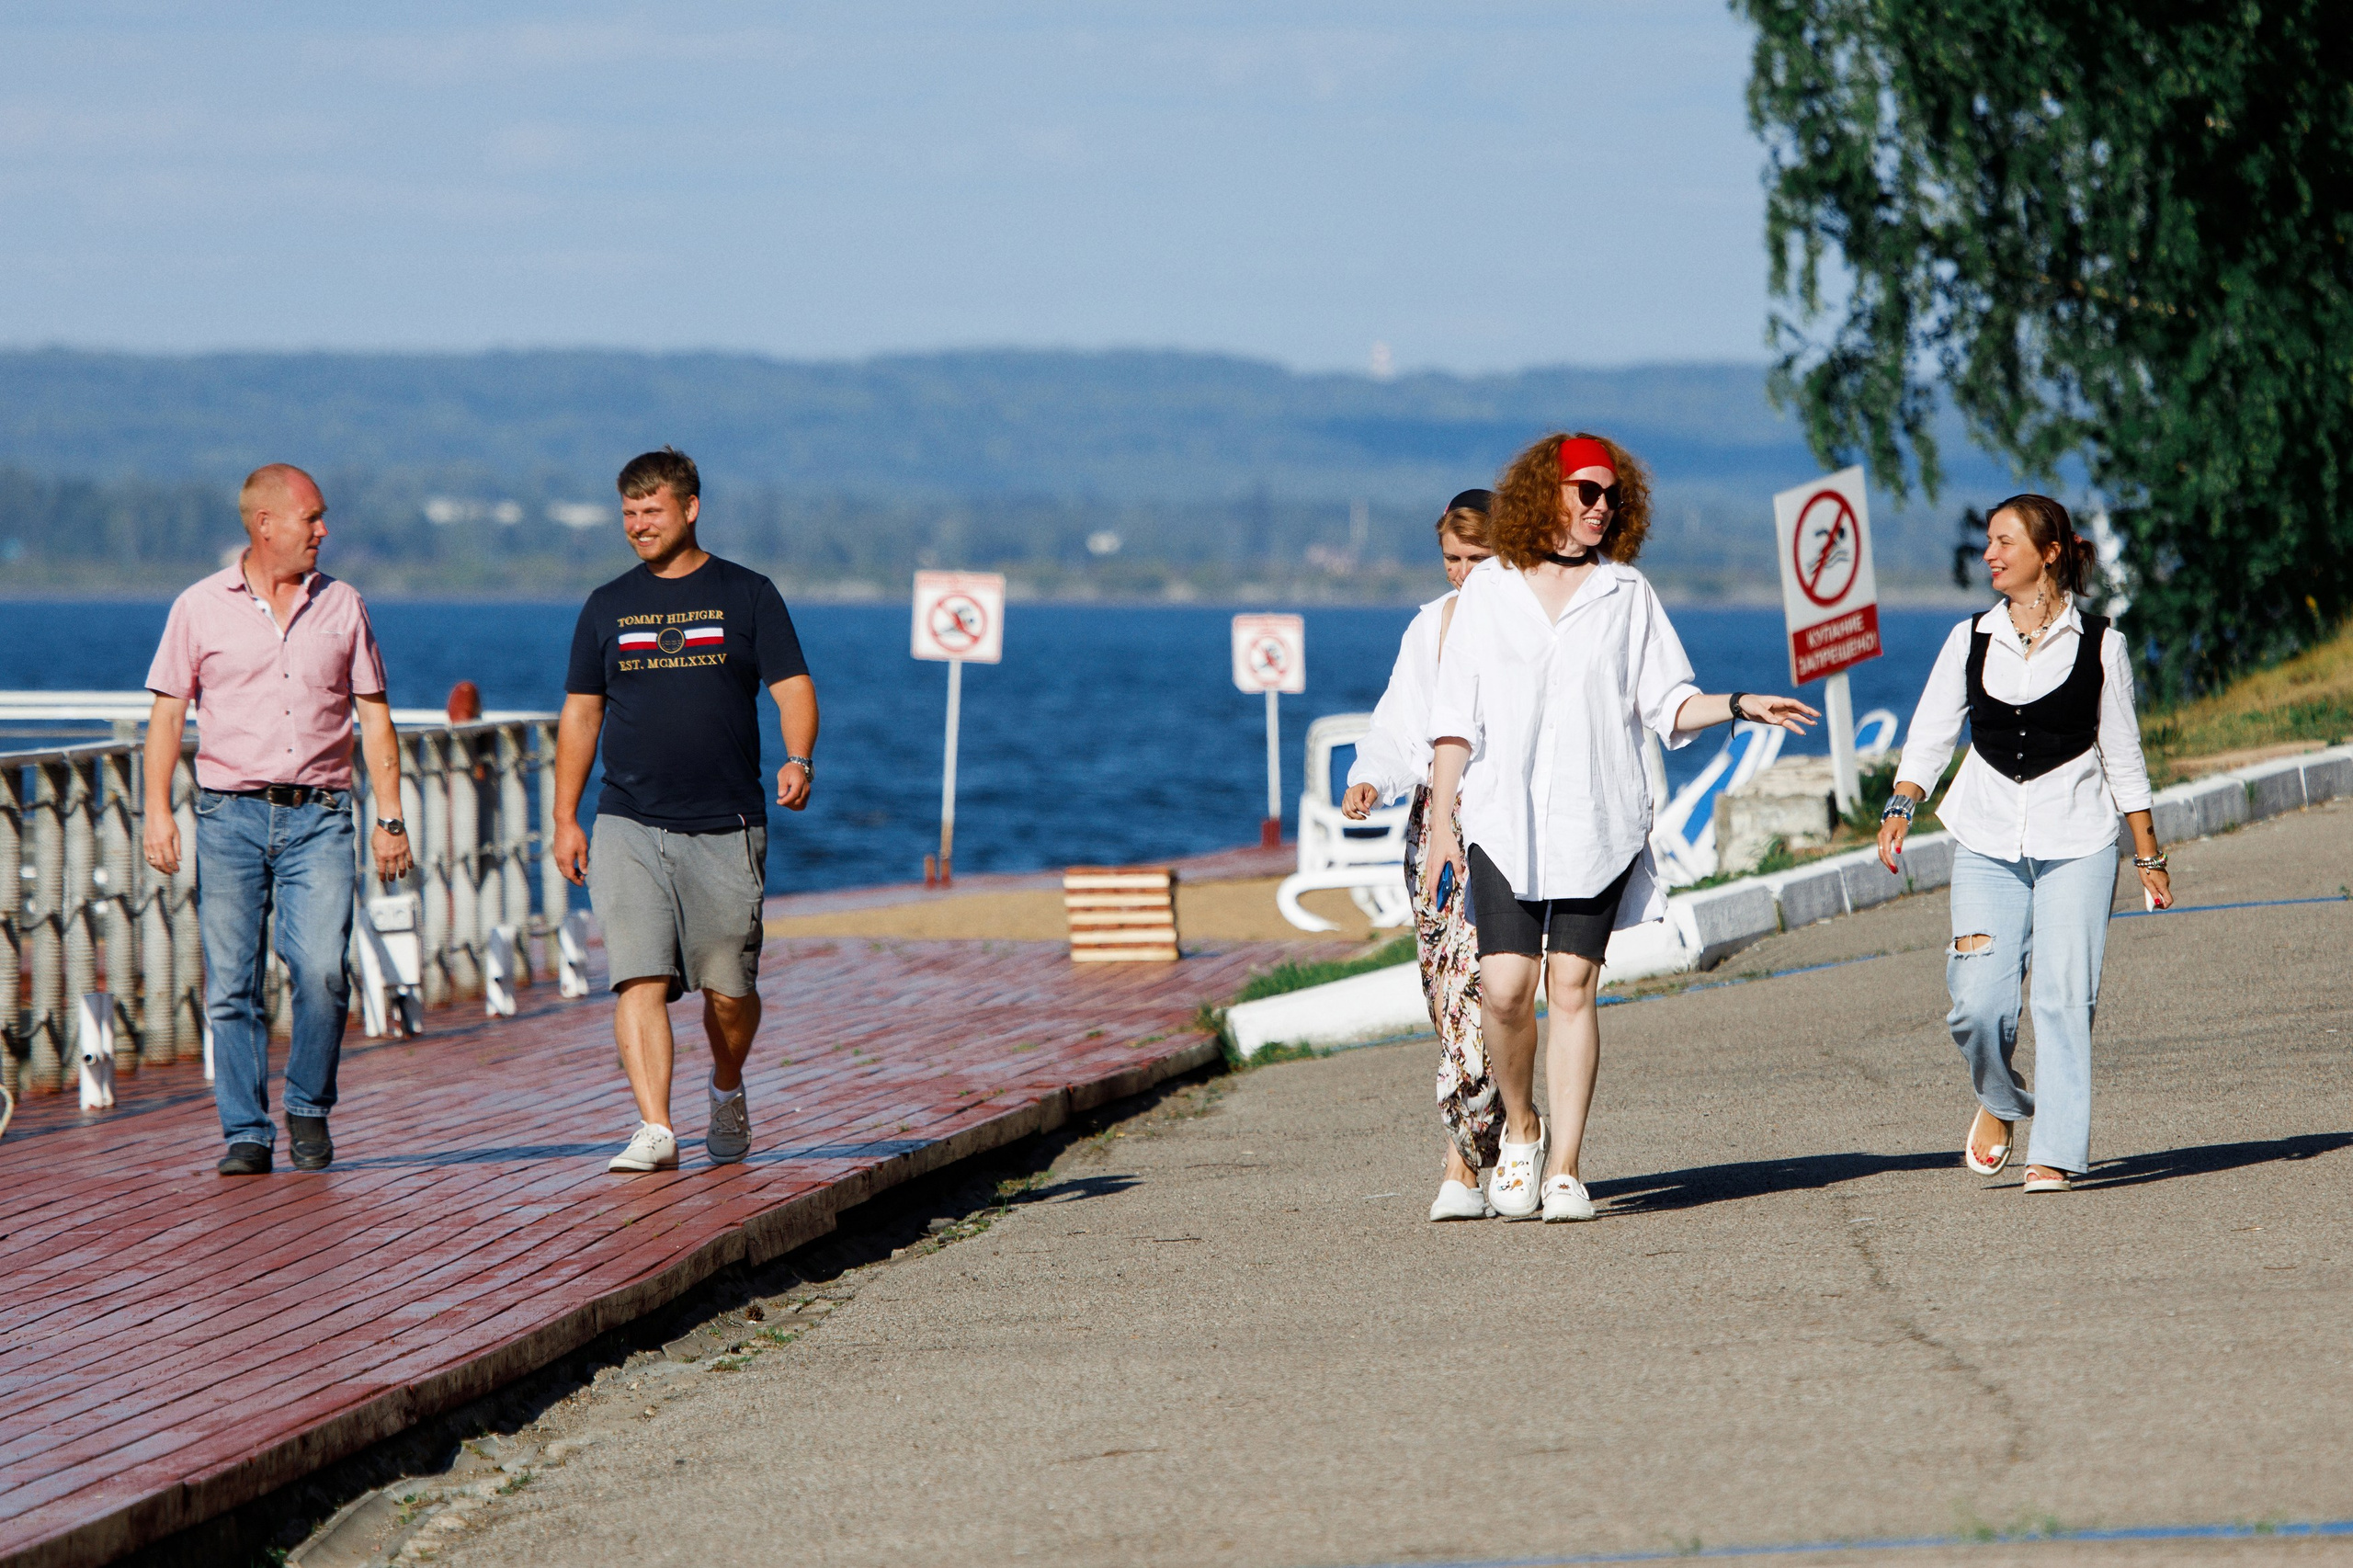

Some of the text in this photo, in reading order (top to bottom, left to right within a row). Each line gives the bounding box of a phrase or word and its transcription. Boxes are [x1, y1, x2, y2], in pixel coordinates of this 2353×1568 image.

[617, 609, 724, 628] TOMMY HILFIGER
[1806, 612, 1864, 649] КУПАНИЕ
[619, 653, 727, 671] EST. MCMLXXXV
